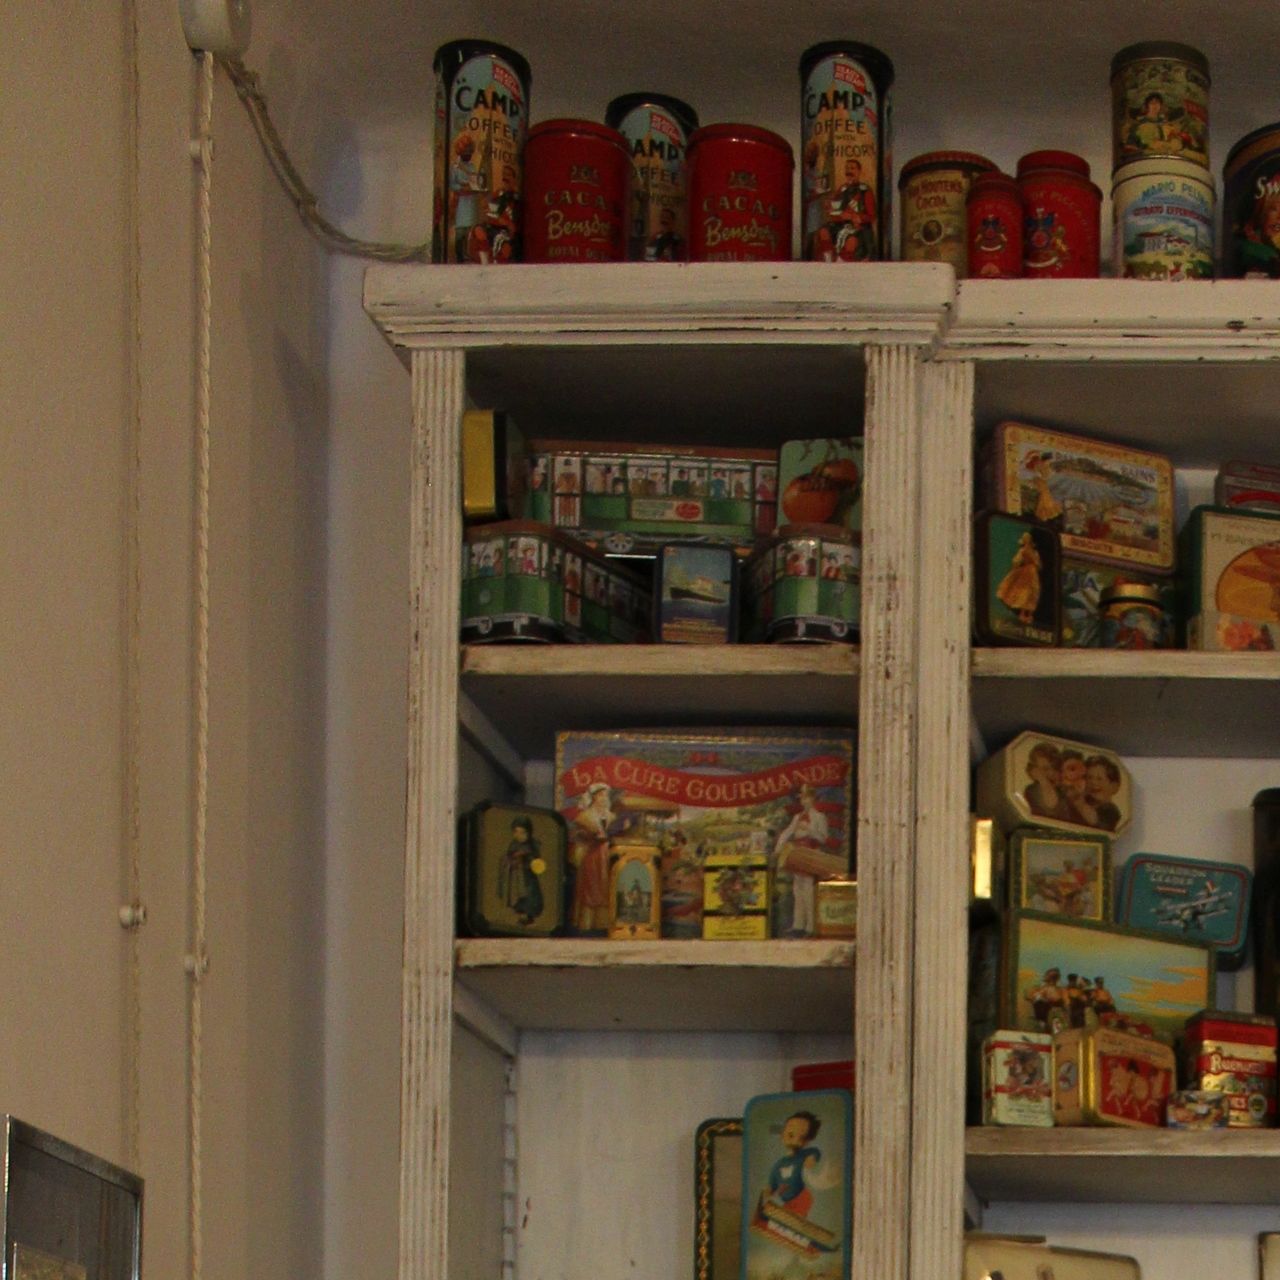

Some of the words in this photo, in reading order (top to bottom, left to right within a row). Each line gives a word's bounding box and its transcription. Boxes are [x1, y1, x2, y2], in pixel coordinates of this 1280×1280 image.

[544, 191, 608, 209] CACA
[573, 764, 608, 789] LA
[612, 759, 680, 794] CURE
[684, 762, 843, 801] GOURMANDE
